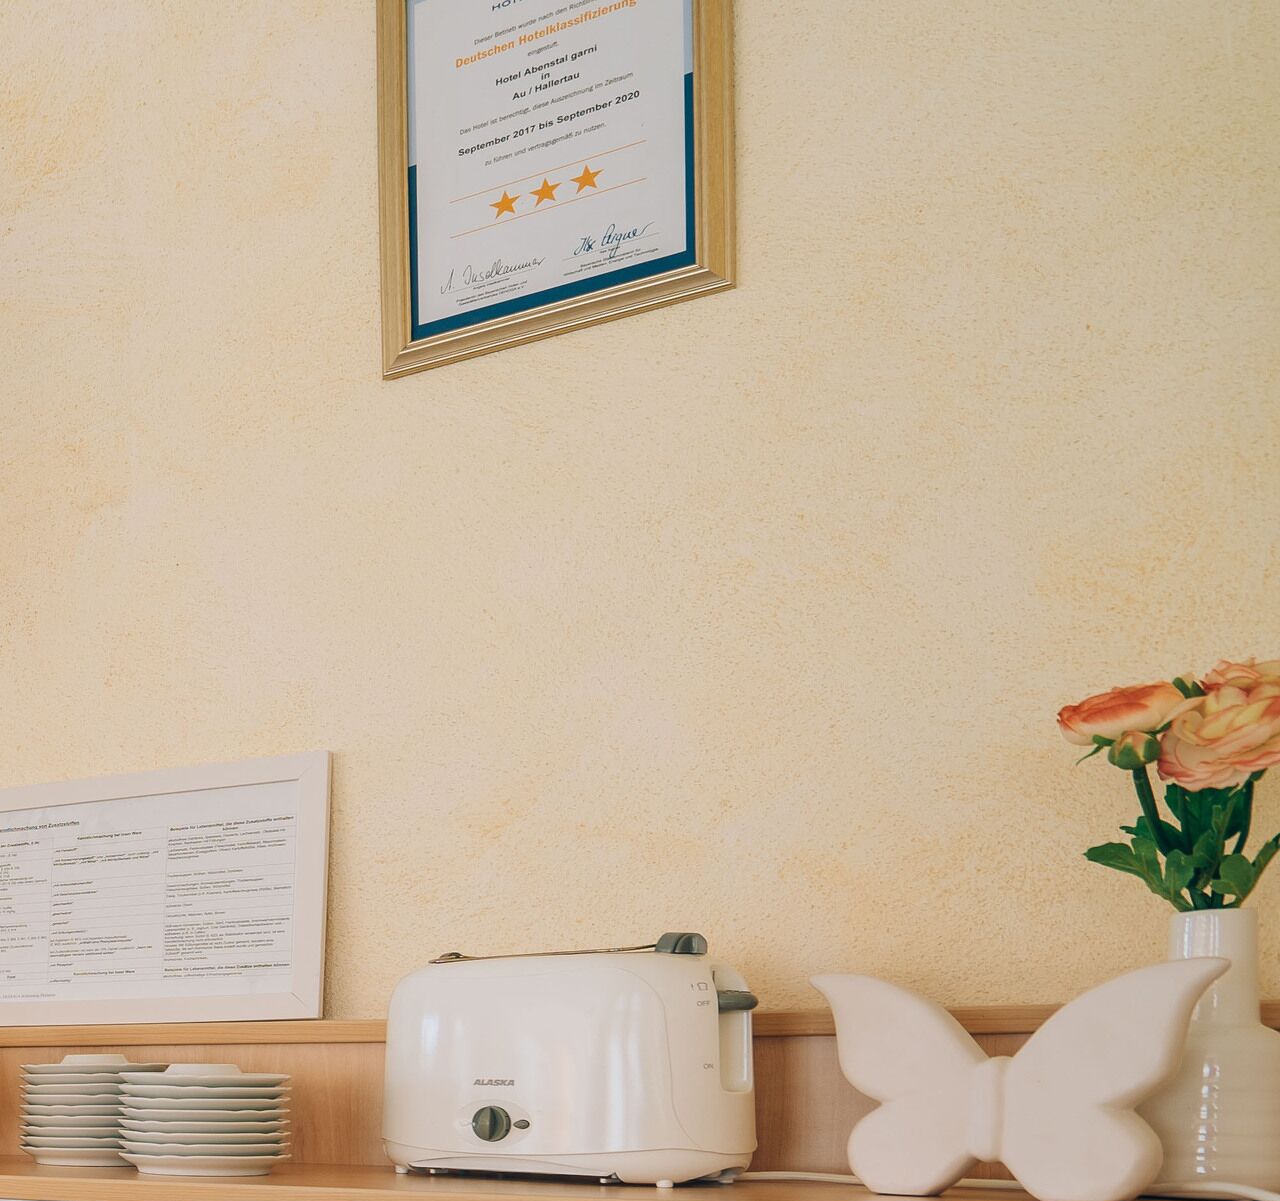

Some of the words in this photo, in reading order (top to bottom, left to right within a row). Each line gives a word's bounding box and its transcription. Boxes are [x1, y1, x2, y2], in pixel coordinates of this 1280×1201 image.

[494, 25, 517, 39] Betrieb
[518, 18, 537, 30] wurde
[538, 11, 554, 25] nach
[455, 39, 515, 69] Deutschen
[495, 71, 521, 87] Hotel
[524, 56, 568, 77] Abenstal
[570, 44, 598, 62] garni
[511, 90, 526, 101] Au
[534, 72, 580, 93] Hallertau
[540, 70, 550, 81] in
[532, 98, 549, 112] diese
[604, 71, 634, 87] Zeitraum
[458, 134, 511, 157] September
[512, 124, 536, 140] 2017
[538, 119, 554, 131] bis
[556, 99, 612, 127] September
[614, 90, 640, 106] 2020
[473, 1079, 515, 1087] ALASKA
